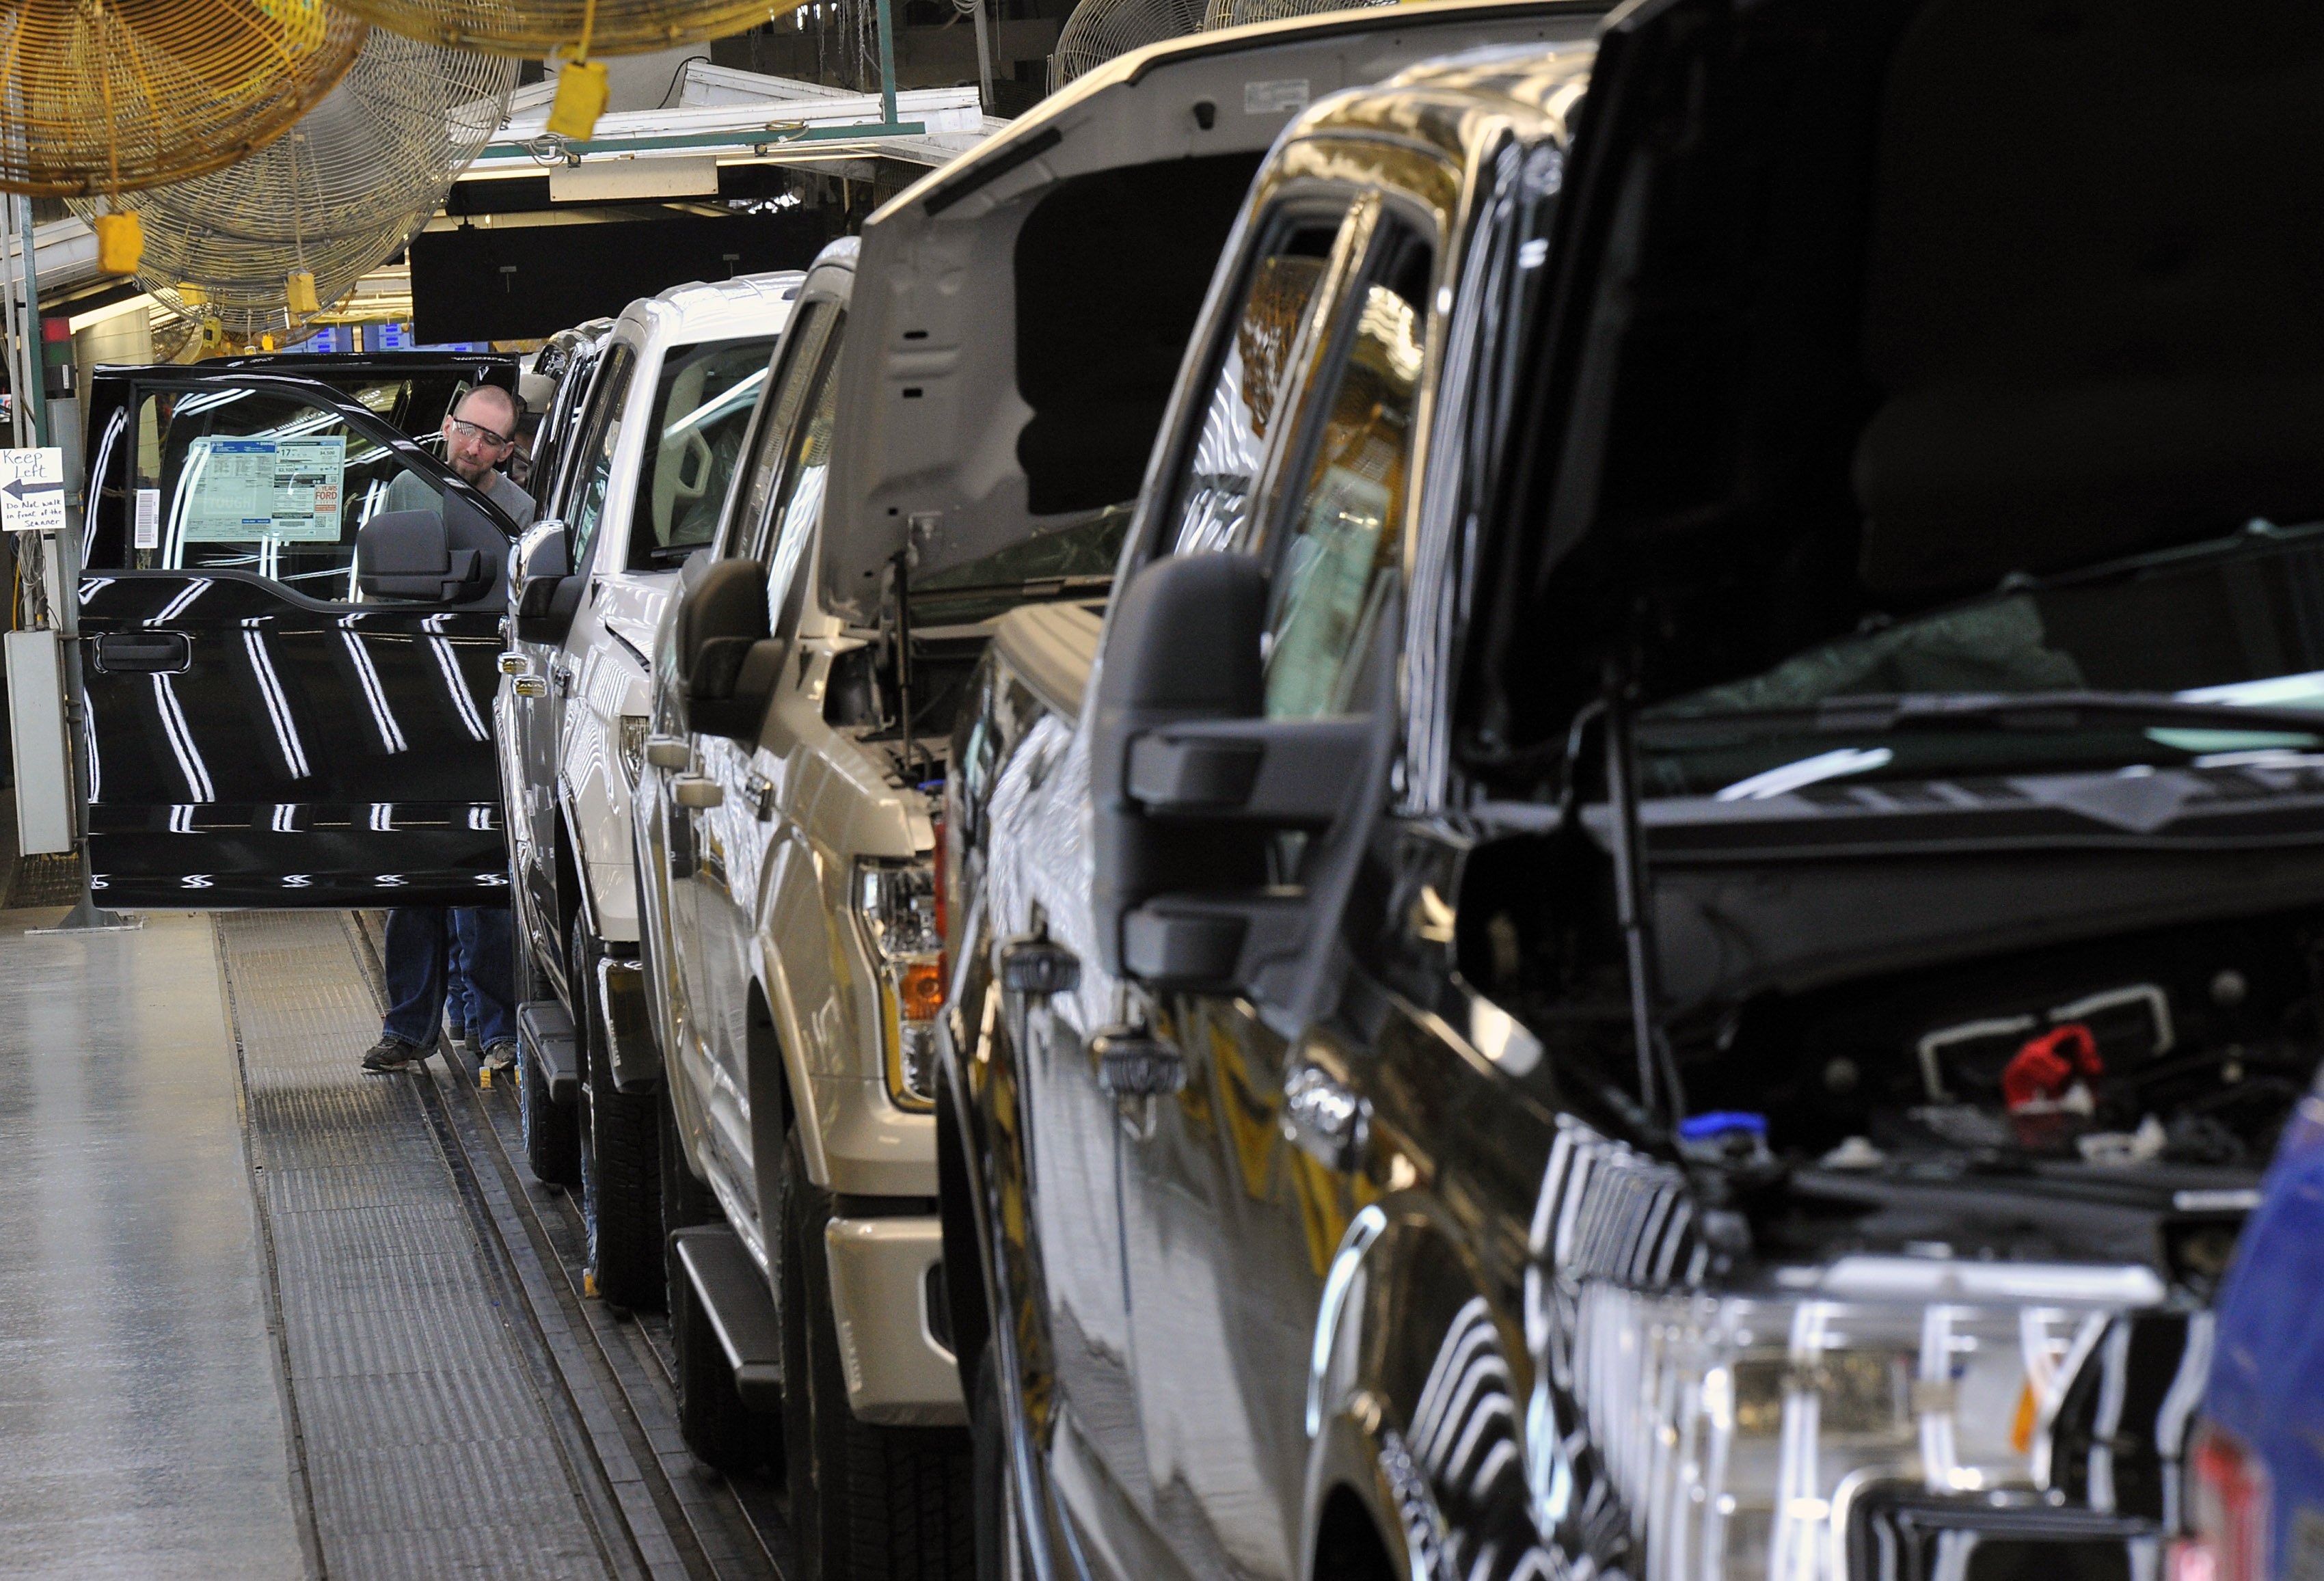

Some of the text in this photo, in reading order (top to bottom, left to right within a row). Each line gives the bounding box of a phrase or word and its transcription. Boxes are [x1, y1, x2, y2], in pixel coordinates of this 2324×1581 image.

[3, 450, 42, 468] Keep
[15, 465, 47, 478] Left
[315, 491, 338, 500] FORD
